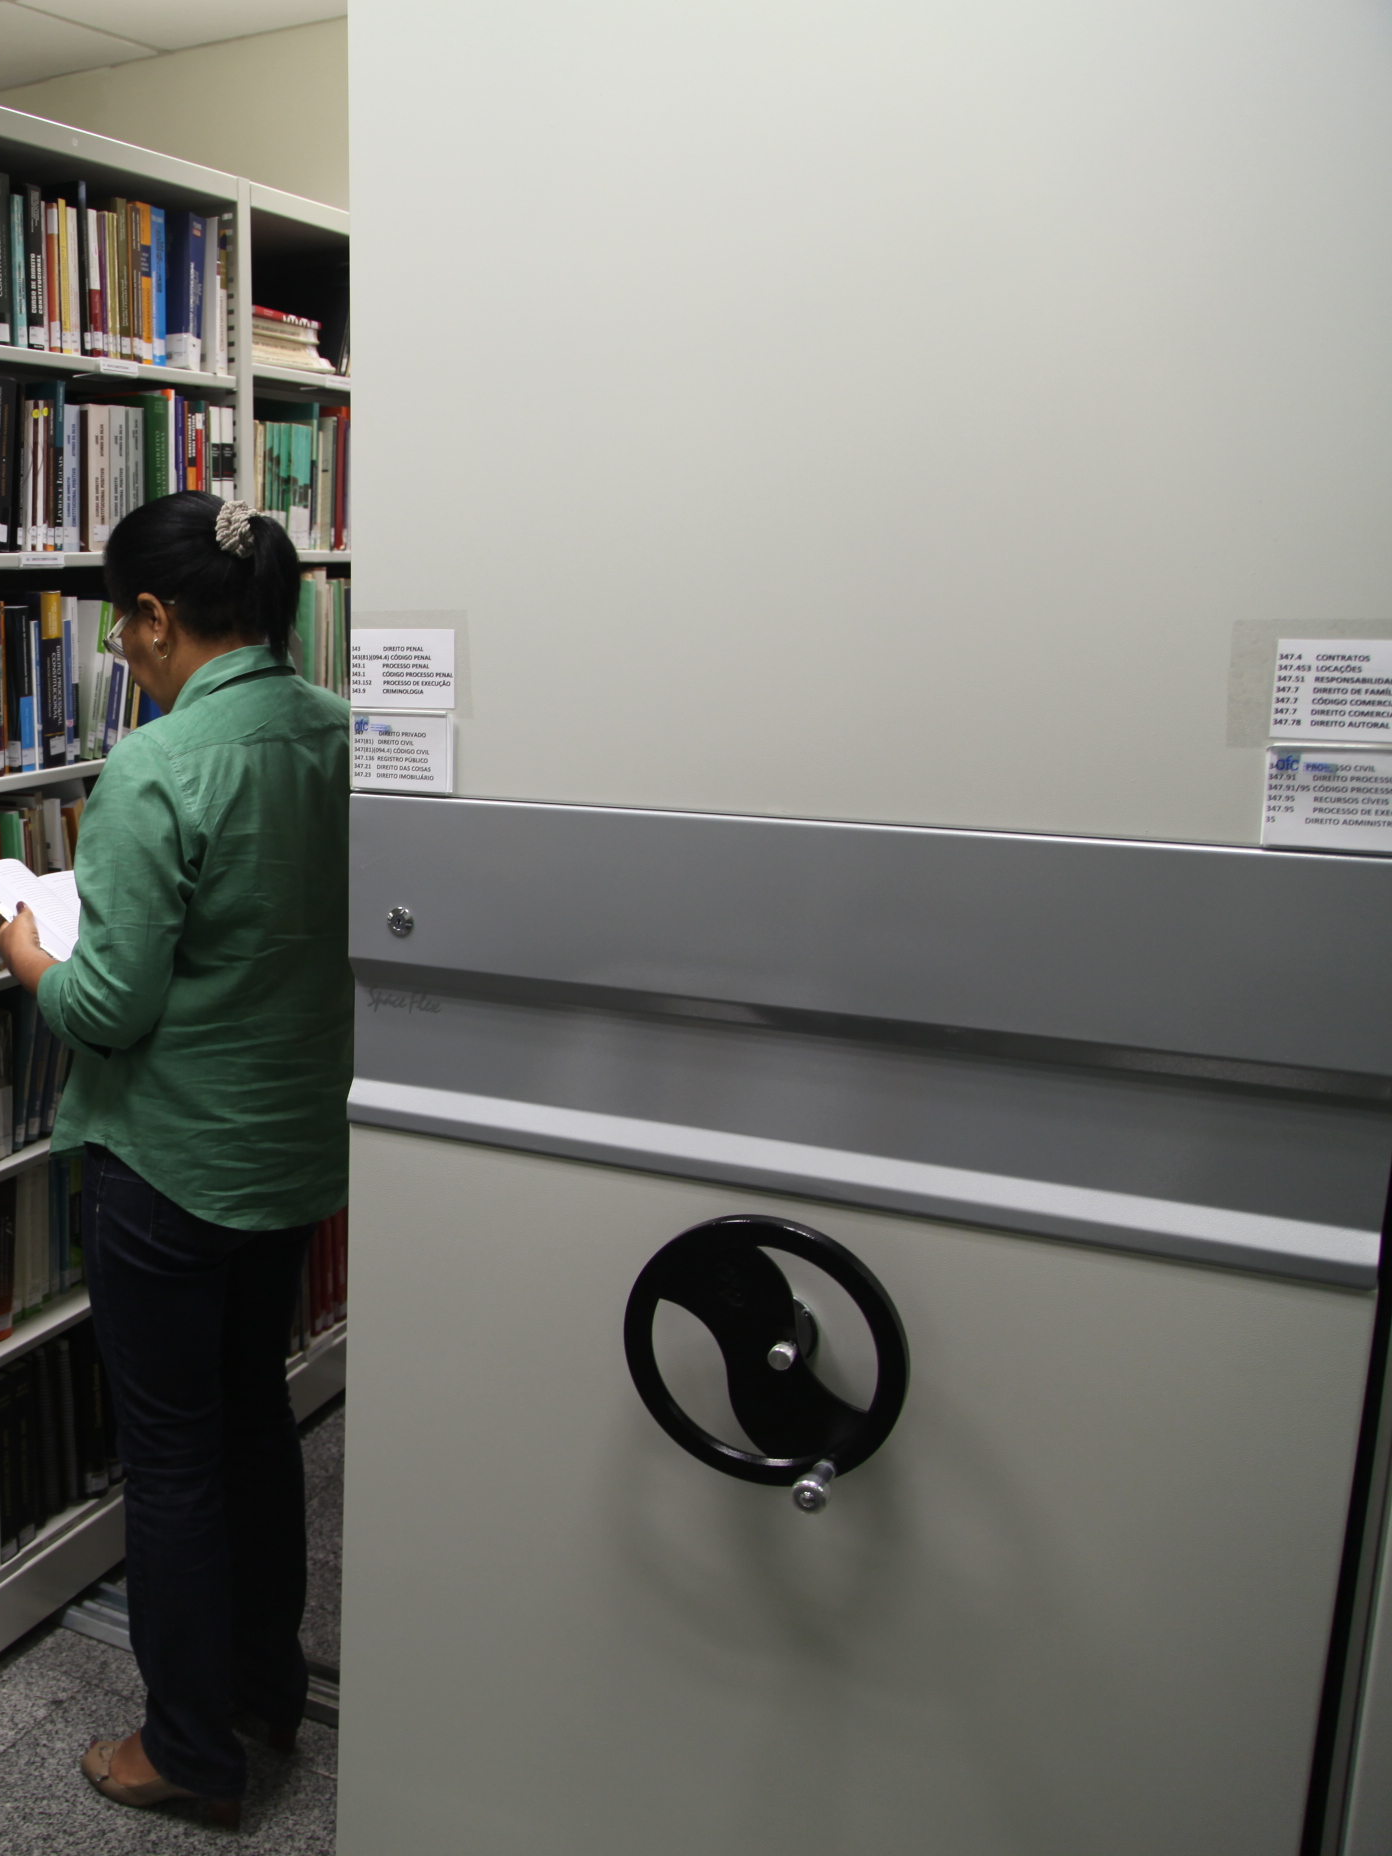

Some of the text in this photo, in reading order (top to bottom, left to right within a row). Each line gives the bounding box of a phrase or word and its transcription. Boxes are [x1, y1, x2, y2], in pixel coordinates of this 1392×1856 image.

[31, 280, 37, 290] DE
[390, 653, 413, 661] CÓDIGO
[1279, 653, 1371, 662] 347.4 CONTRATOS
[1278, 664, 1362, 674] 347.453 LOCAÇÕES
[421, 679, 451, 687] EXECUÇÃO
[1276, 675, 1392, 685] 347.51 RESPONSABILIDA
[1275, 696, 1392, 707] 347.7 CÓDIGO COMERCI
[1273, 718, 1390, 729] 347.78 DIREITO AUTORAL
[393, 747, 415, 755] CÓDIGO
[405, 756, 429, 764] PÚBLICO
[411, 765, 431, 773] COISAS
[1353, 765, 1376, 773] CIVIL
[399, 773, 434, 781] IMOBILIÁRIO
[1268, 773, 1296, 781] 347.91
[1313, 774, 1348, 782] DIREITO
[1312, 784, 1348, 793] CÓDIGO
[1313, 796, 1359, 804] RECURSOS
[1361, 797, 1389, 806] CÍVEIS
[1267, 805, 1294, 813] 347.95
[1312, 806, 1358, 815] PROCESSO
[1305, 817, 1340, 825] DIREITO
